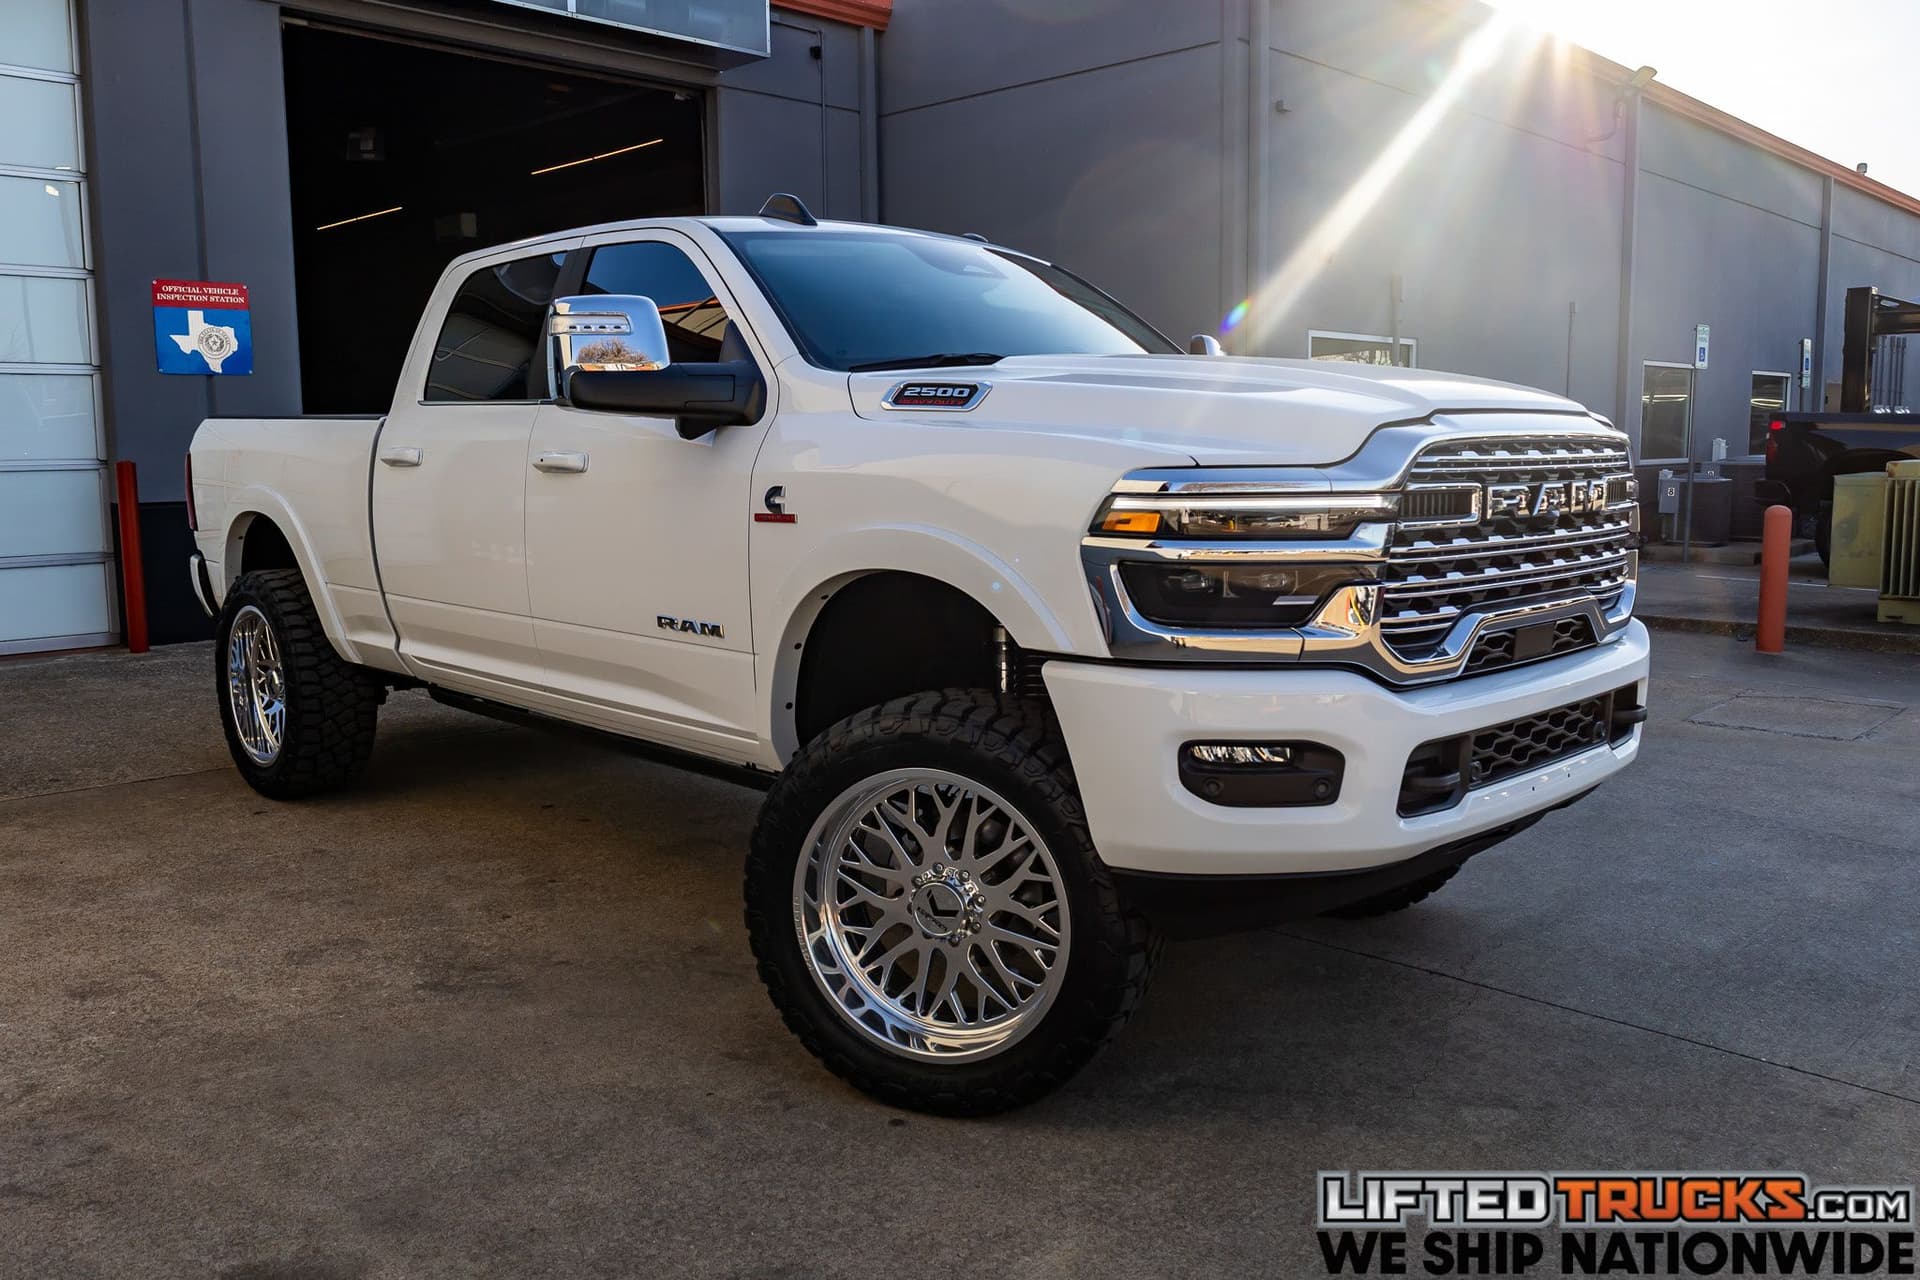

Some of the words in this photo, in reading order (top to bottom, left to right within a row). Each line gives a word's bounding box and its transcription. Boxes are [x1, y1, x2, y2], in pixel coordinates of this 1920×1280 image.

[162, 285, 202, 294] OFFICIAL
[202, 287, 239, 296] VEHICLE
[157, 293, 208, 302] INSPECTION
[209, 295, 245, 304] STATION
[903, 386, 970, 397] 2500
[1481, 478, 1607, 522] RAM
[656, 615, 725, 639] RAM
